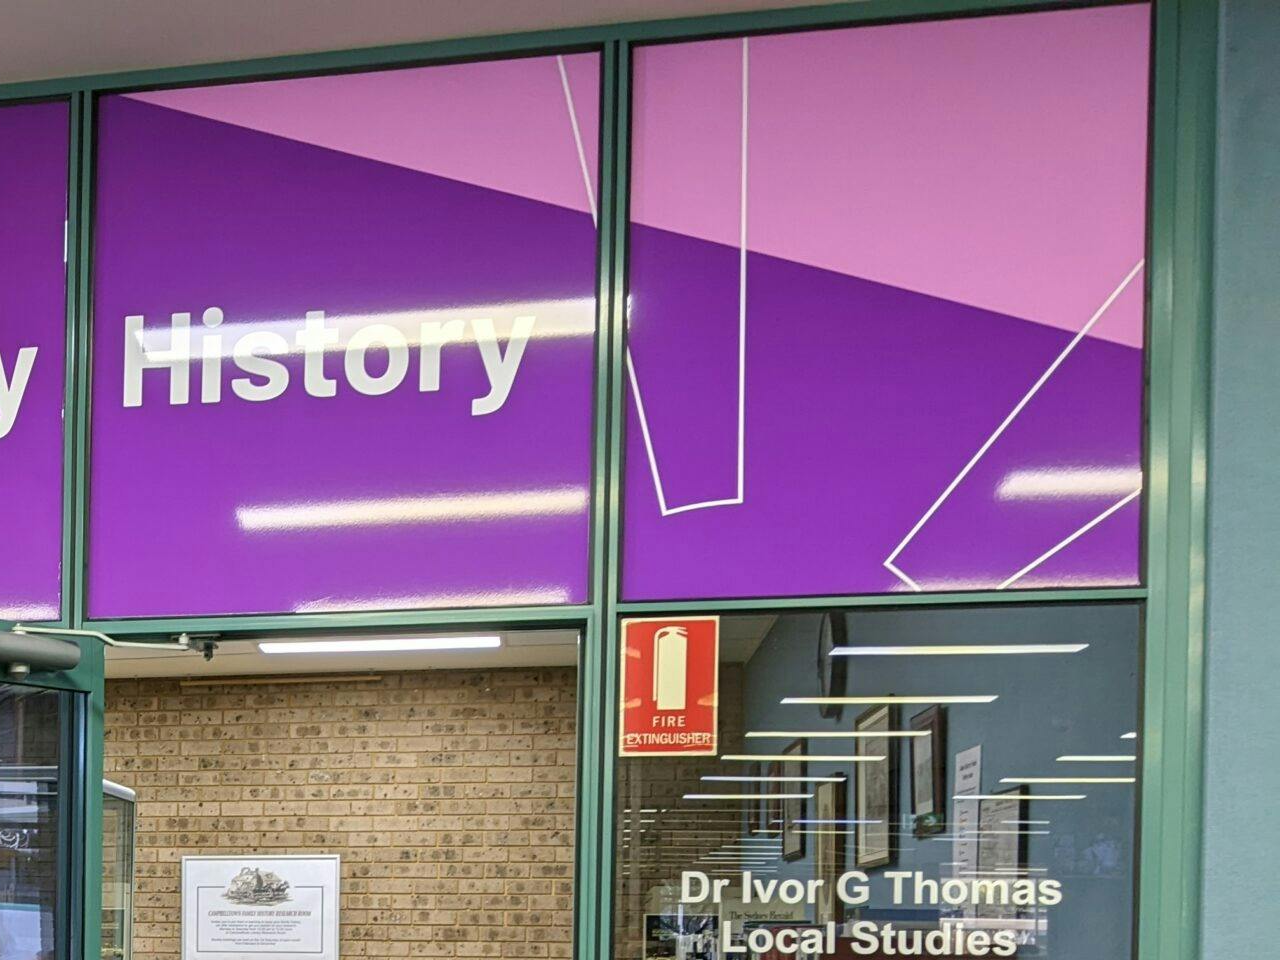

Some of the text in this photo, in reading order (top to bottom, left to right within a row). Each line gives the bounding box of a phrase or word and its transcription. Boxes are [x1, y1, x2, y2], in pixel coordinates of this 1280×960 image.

[122, 306, 538, 418] History
[626, 732, 712, 745] EXTINGUISHER
[652, 715, 686, 728] FIRE
[679, 870, 1063, 906] Dr Ivor G Thomas
[722, 920, 1018, 956] Local Studies
